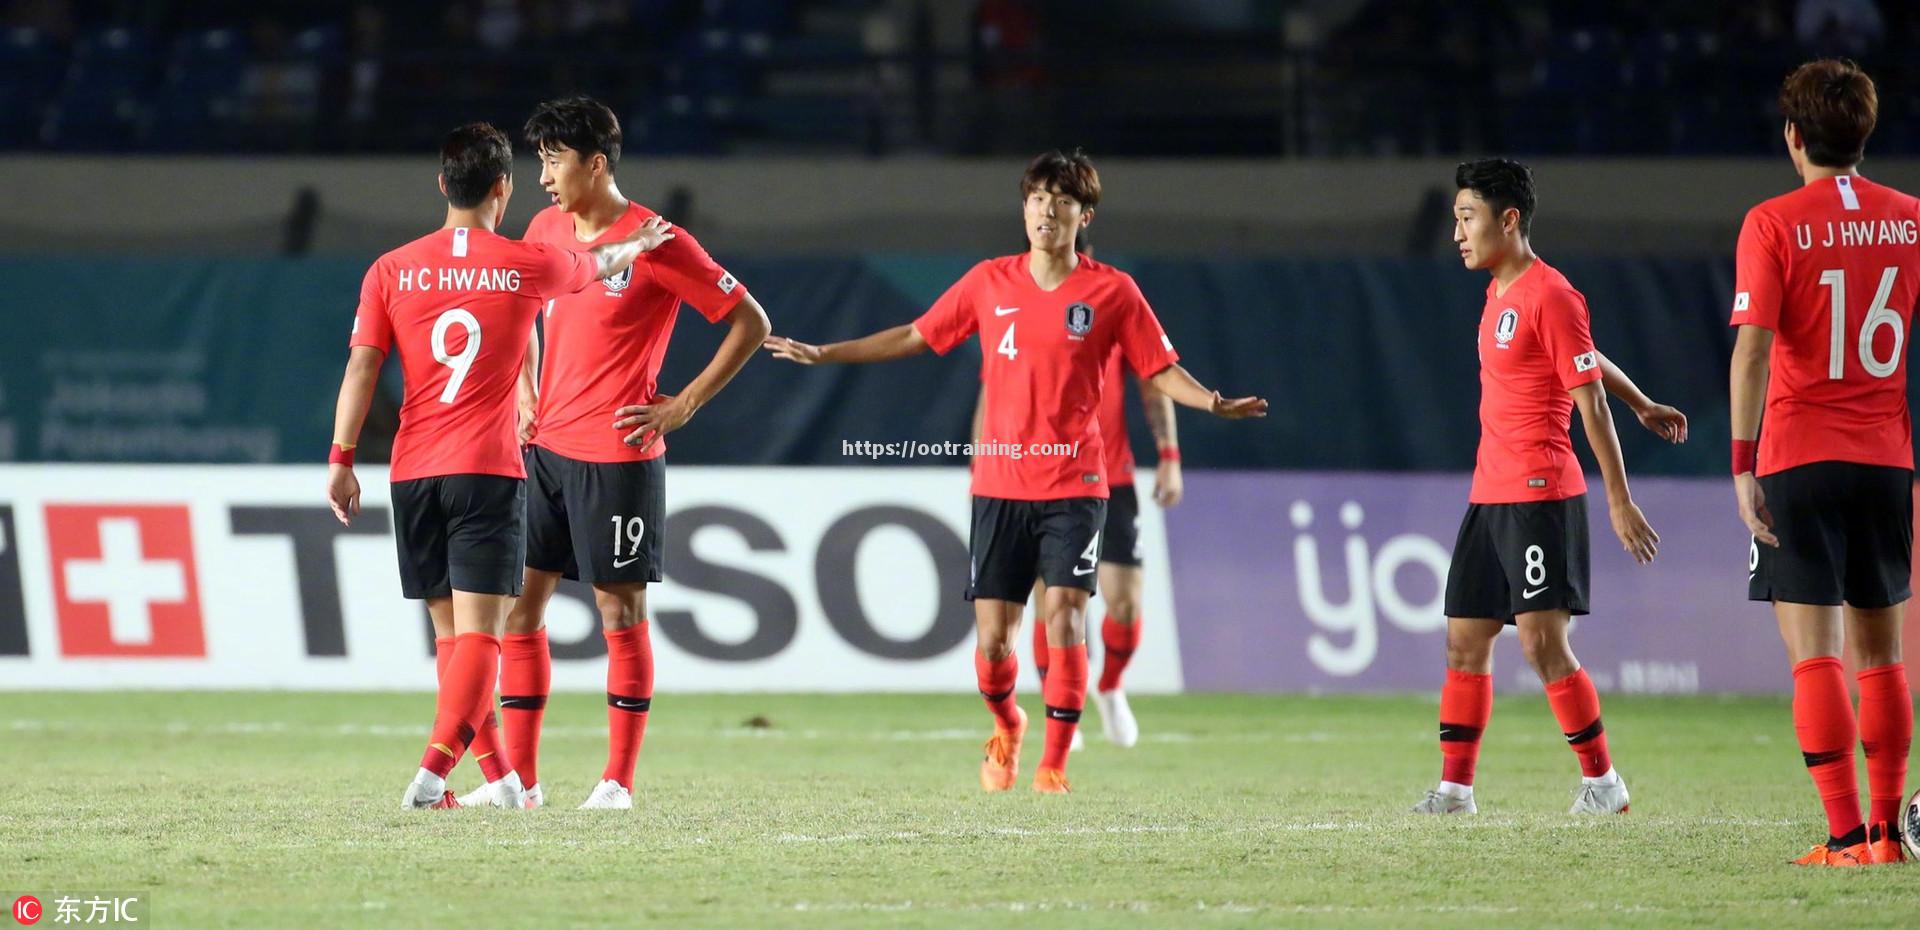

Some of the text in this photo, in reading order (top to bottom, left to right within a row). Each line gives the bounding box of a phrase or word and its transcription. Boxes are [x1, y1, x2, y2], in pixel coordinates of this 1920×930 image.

[1796, 219, 1918, 249] U J HWANG
[398, 267, 521, 292] H C HWANG
[997, 320, 1019, 361] 4
[1819, 266, 1904, 380] 16
[430, 307, 482, 404] 9
[611, 515, 645, 556] 19
[1080, 528, 1100, 569] 4
[1524, 544, 1547, 586] 8
